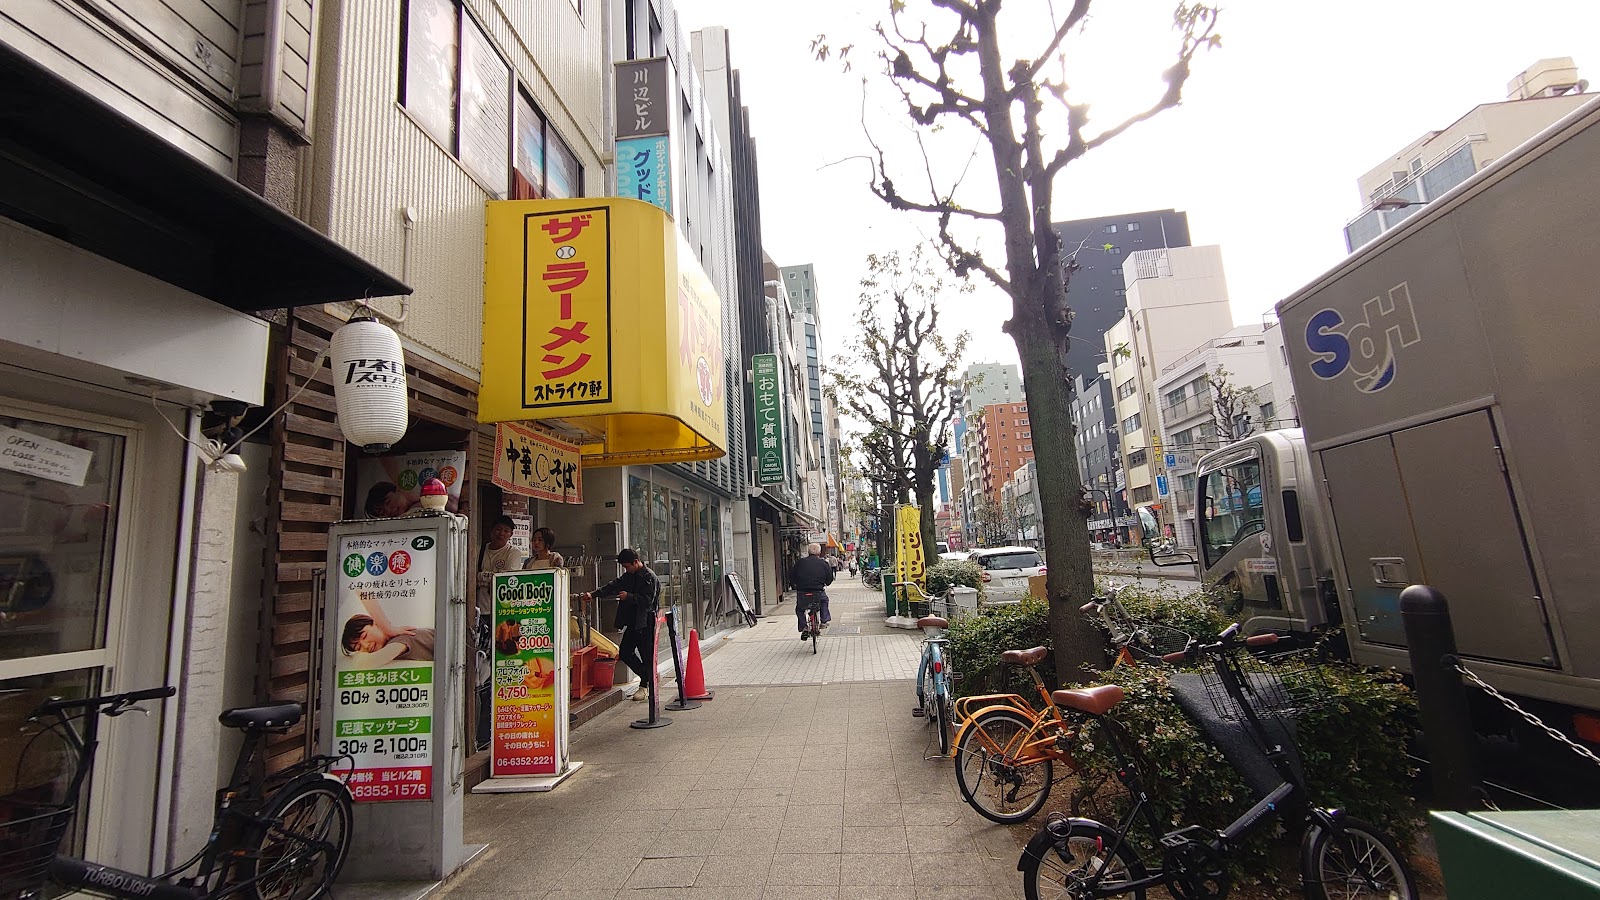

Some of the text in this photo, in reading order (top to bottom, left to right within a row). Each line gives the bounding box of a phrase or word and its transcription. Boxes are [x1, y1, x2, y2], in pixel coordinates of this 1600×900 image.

[633, 68, 652, 131] 川辺ビル
[634, 149, 651, 201] グッド
[540, 262, 592, 380] ラーメン
[679, 286, 723, 403] ストライク
[533, 380, 603, 402] ストライク軒
[759, 377, 777, 448] おもて質舗
[7, 435, 40, 450] OPEN
[2, 448, 37, 461] CLOSE
[505, 439, 532, 482] 中華
[550, 458, 577, 490] そば
[345, 537, 430, 550] 本格的なマッサージ 2F
[370, 554, 385, 572] 楽
[348, 577, 428, 591] 心身の疲れをリセット
[359, 589, 417, 601] 慢性疲労の改善
[498, 582, 553, 603] Good Body
[343, 670, 420, 685] 全身もみほぐし
[496, 667, 530, 676] アロマオイル
[496, 677, 524, 685] マッサージ
[340, 687, 428, 705] 60分 3,000円
[341, 719, 420, 735] 足裏マッサージ
[498, 731, 540, 740] その日の疲れは
[338, 737, 427, 755] 30分 2,100円
[497, 756, 554, 767] 06-6352-2221
[381, 769, 422, 781] 当ビル2階
